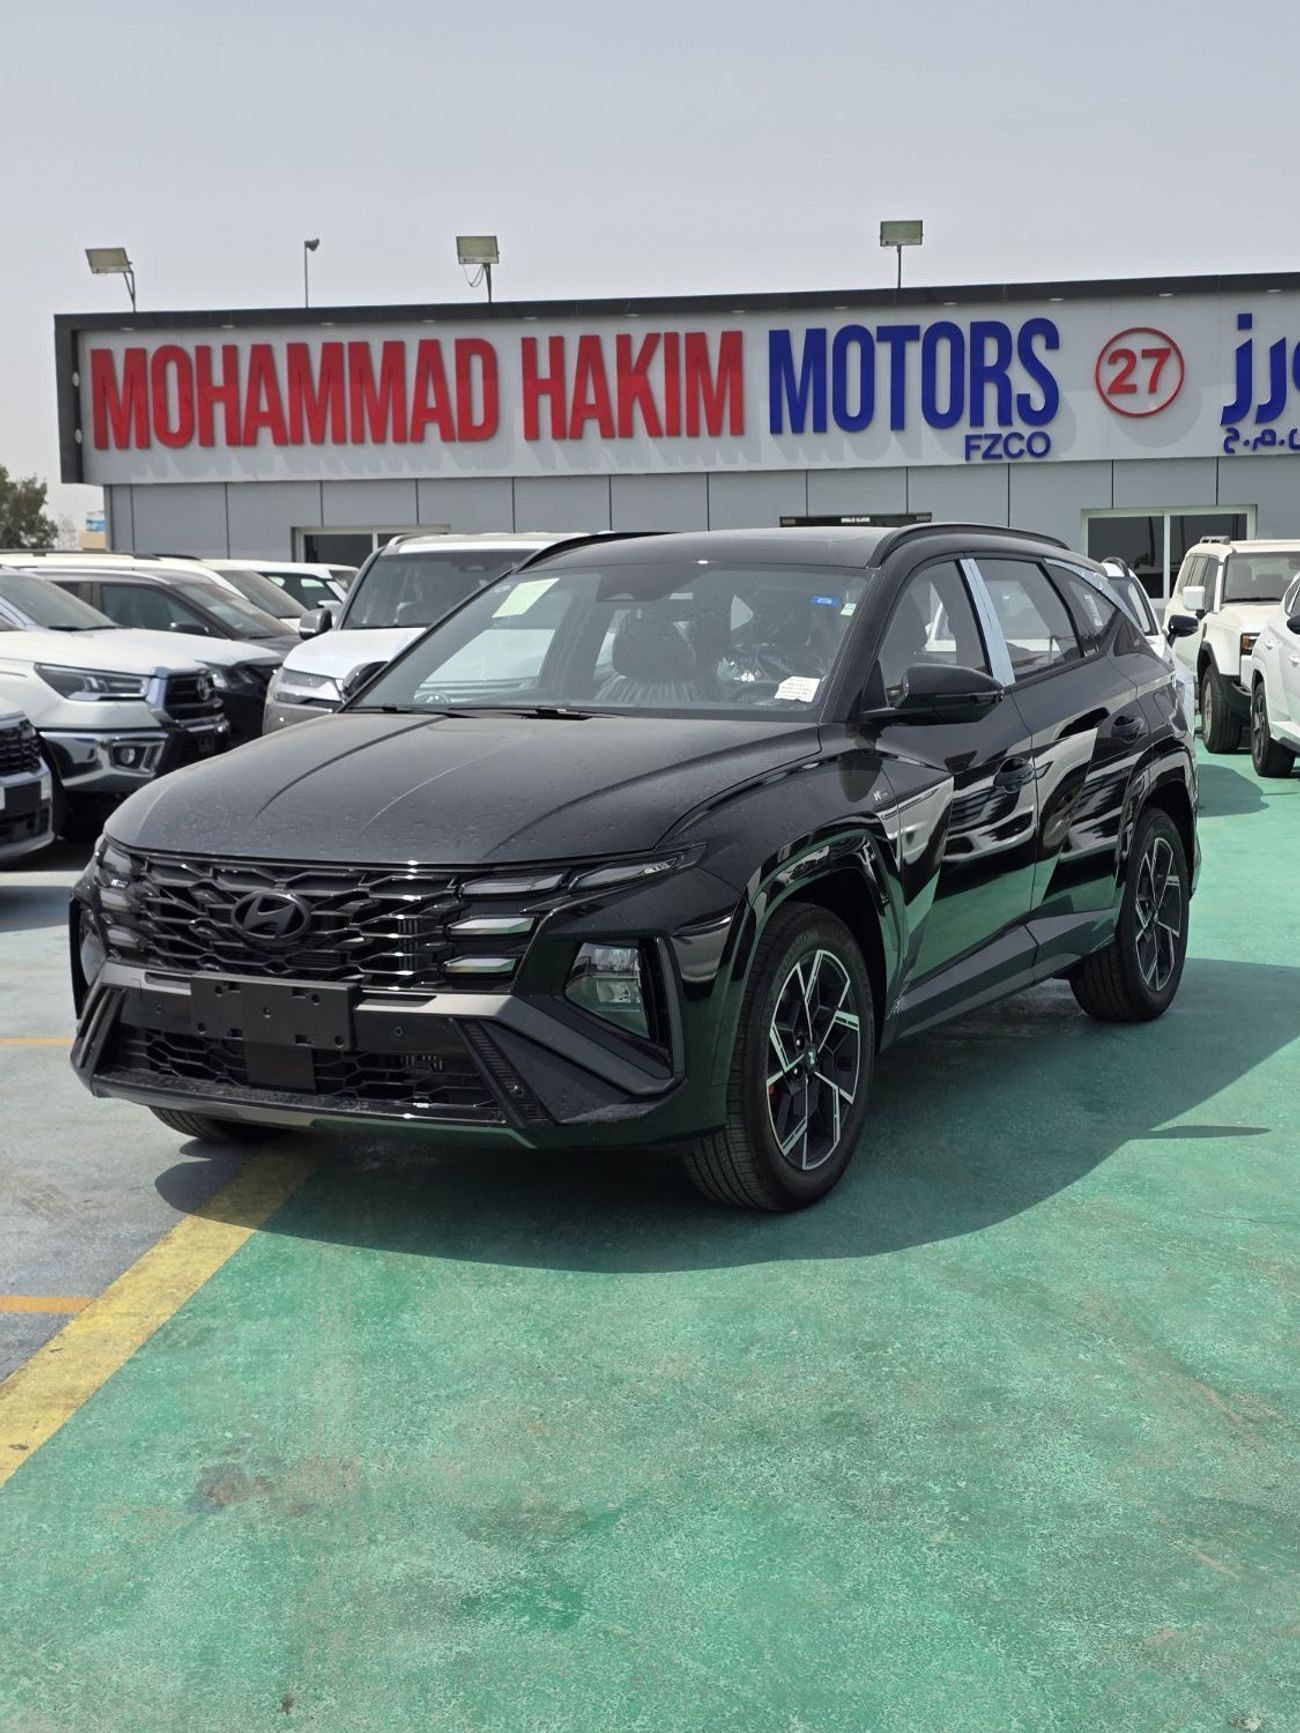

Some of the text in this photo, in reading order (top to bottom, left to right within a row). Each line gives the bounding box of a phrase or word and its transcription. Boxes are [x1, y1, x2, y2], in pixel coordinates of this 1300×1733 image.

[90, 317, 1061, 450] MOHAMMAD HAKIM MOTORS
[1107, 347, 1171, 395] 27
[1220, 313, 1300, 425] رز
[964, 430, 1052, 461] FZCO
